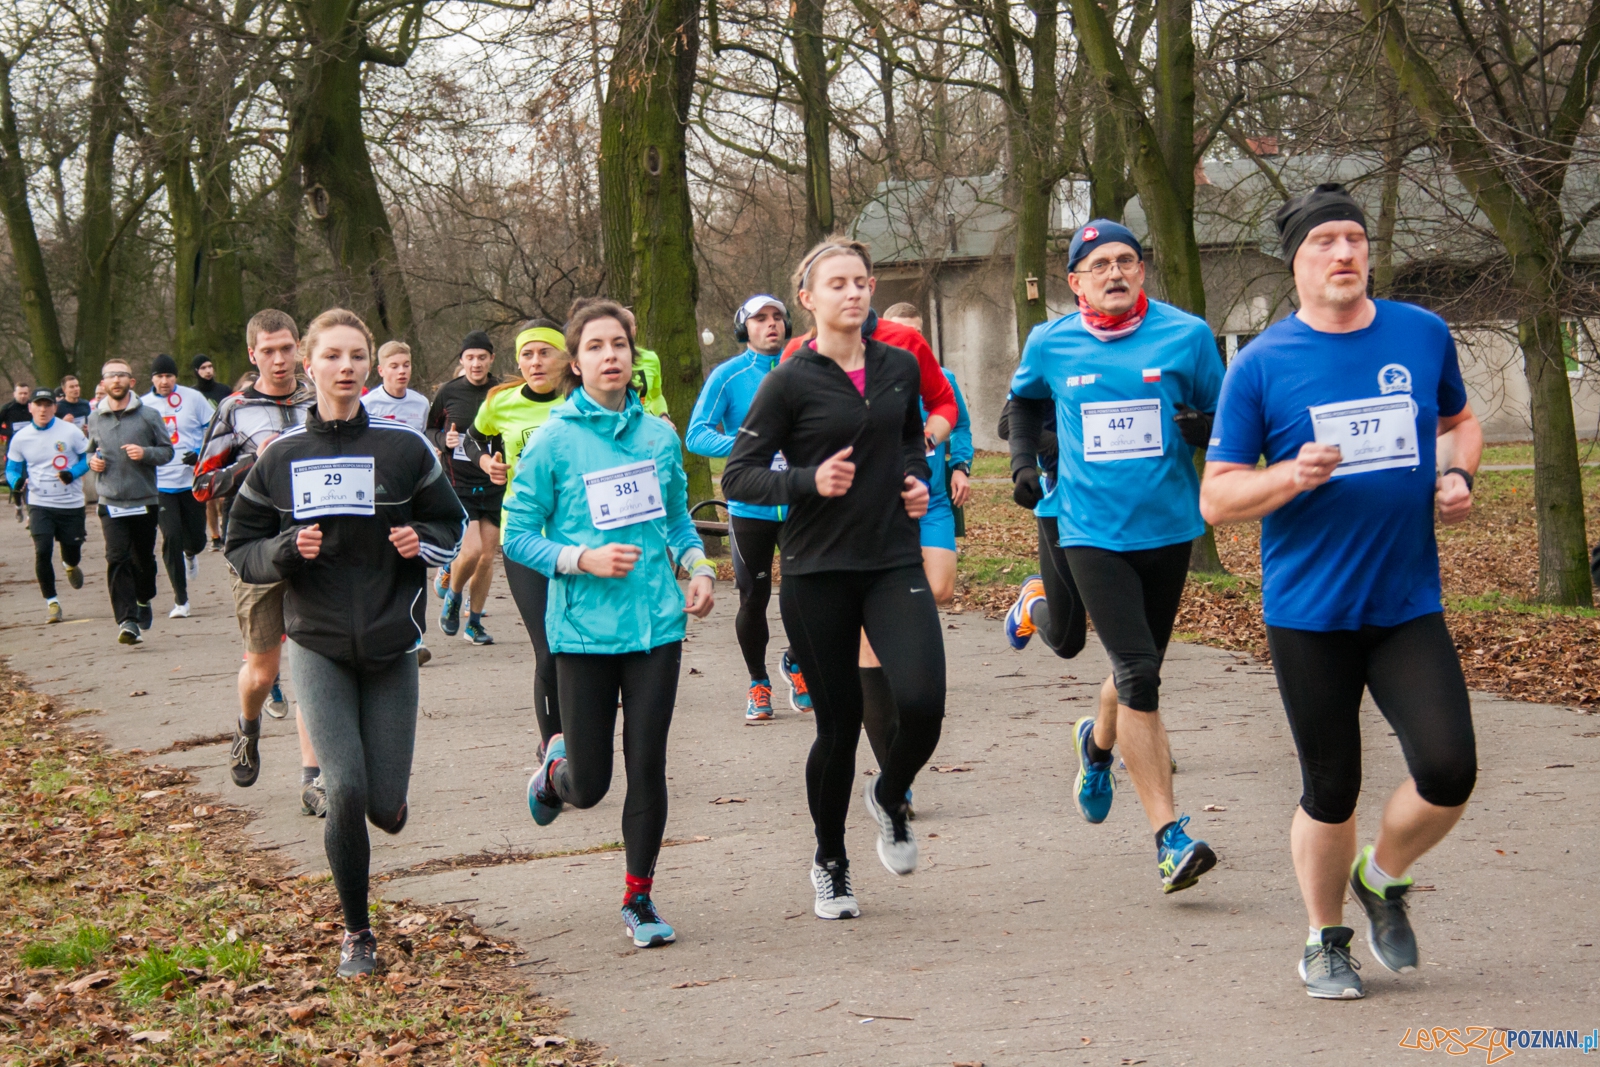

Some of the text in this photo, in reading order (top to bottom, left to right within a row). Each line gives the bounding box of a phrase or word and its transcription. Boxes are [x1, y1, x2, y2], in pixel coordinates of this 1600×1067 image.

[1108, 417, 1134, 430] 447
[1350, 418, 1380, 436] 377
[324, 473, 342, 485] 29
[614, 480, 639, 497] 381
[320, 489, 347, 502] parkrun
